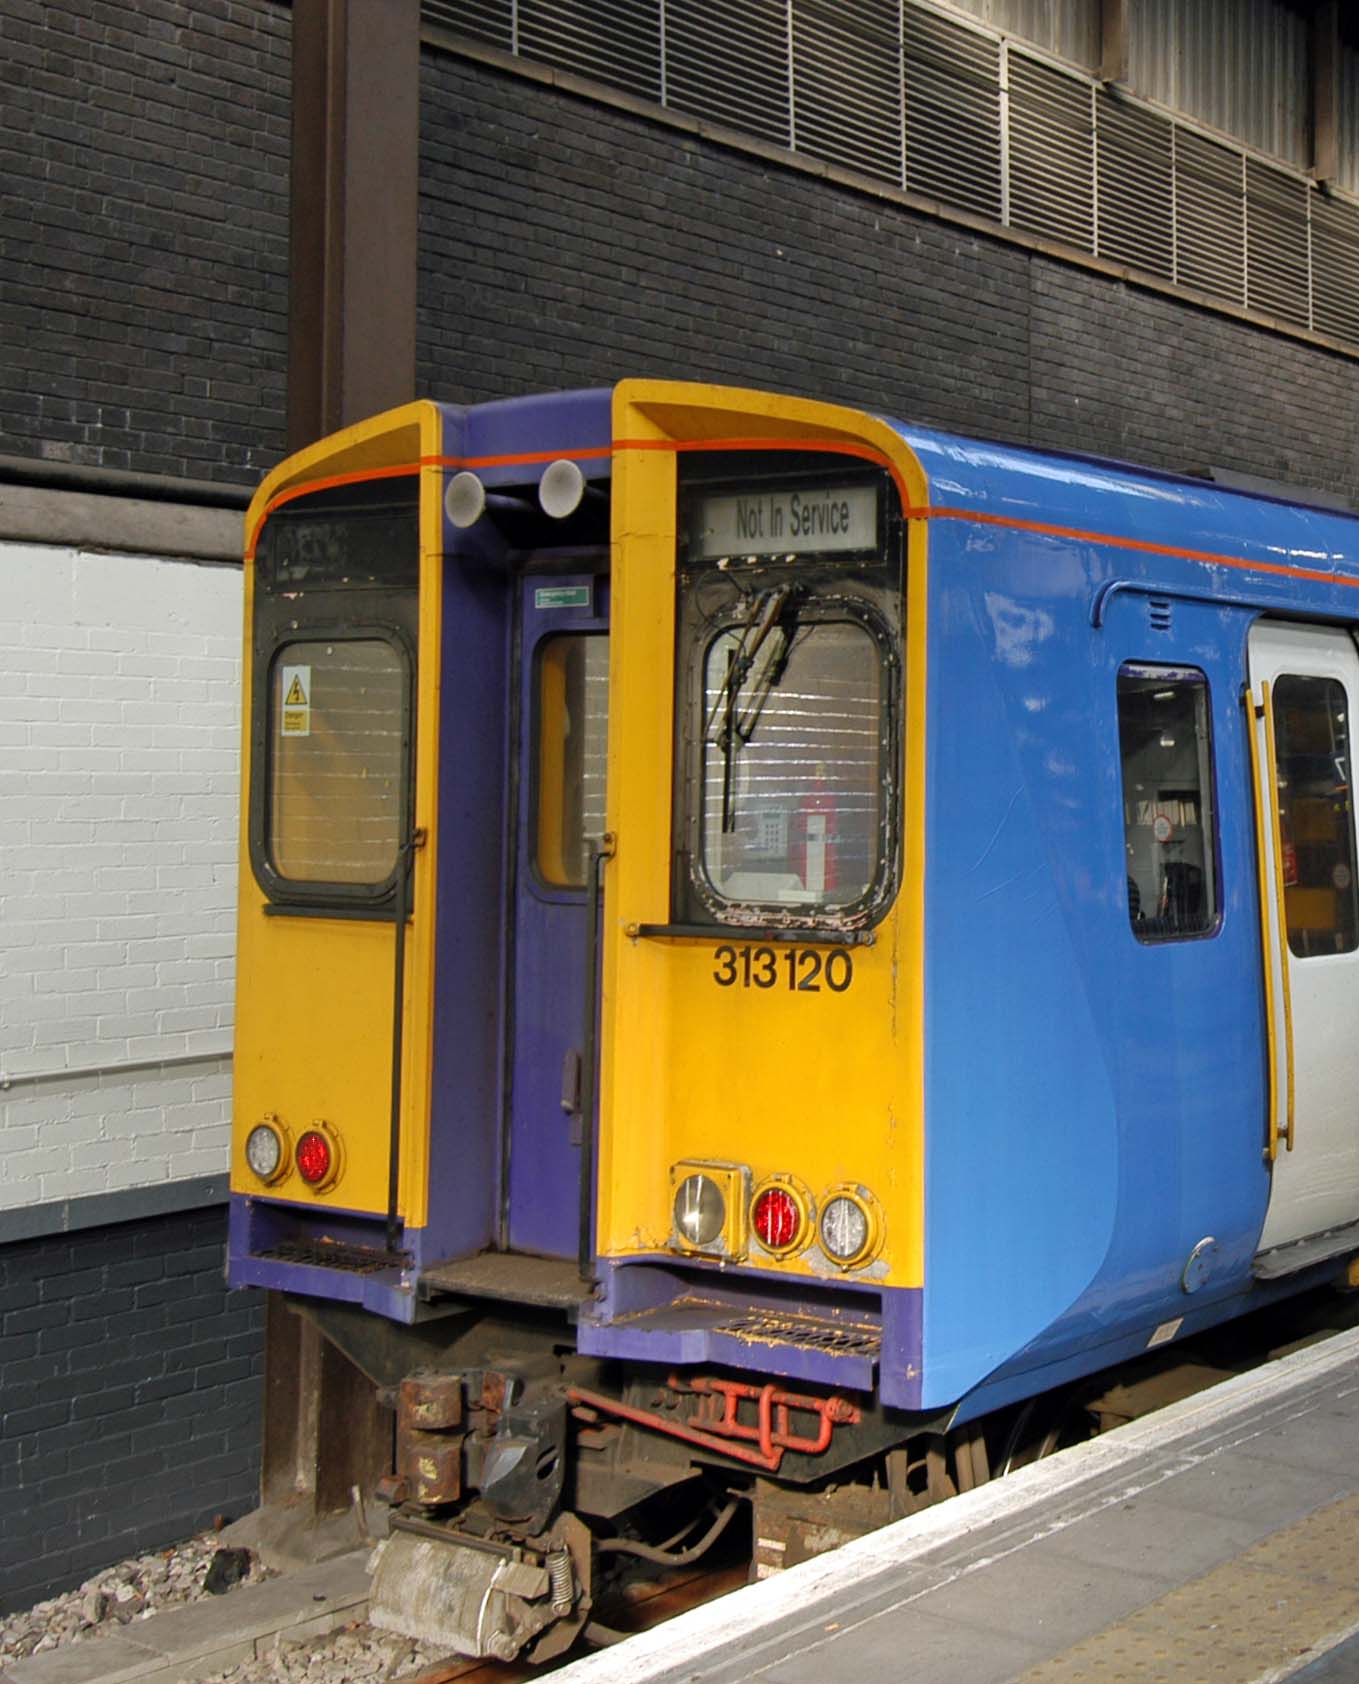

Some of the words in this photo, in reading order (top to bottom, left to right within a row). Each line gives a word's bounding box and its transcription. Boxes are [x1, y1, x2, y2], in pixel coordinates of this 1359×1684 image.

[736, 500, 763, 538] Not
[769, 498, 783, 537] In
[789, 489, 849, 536] Service
